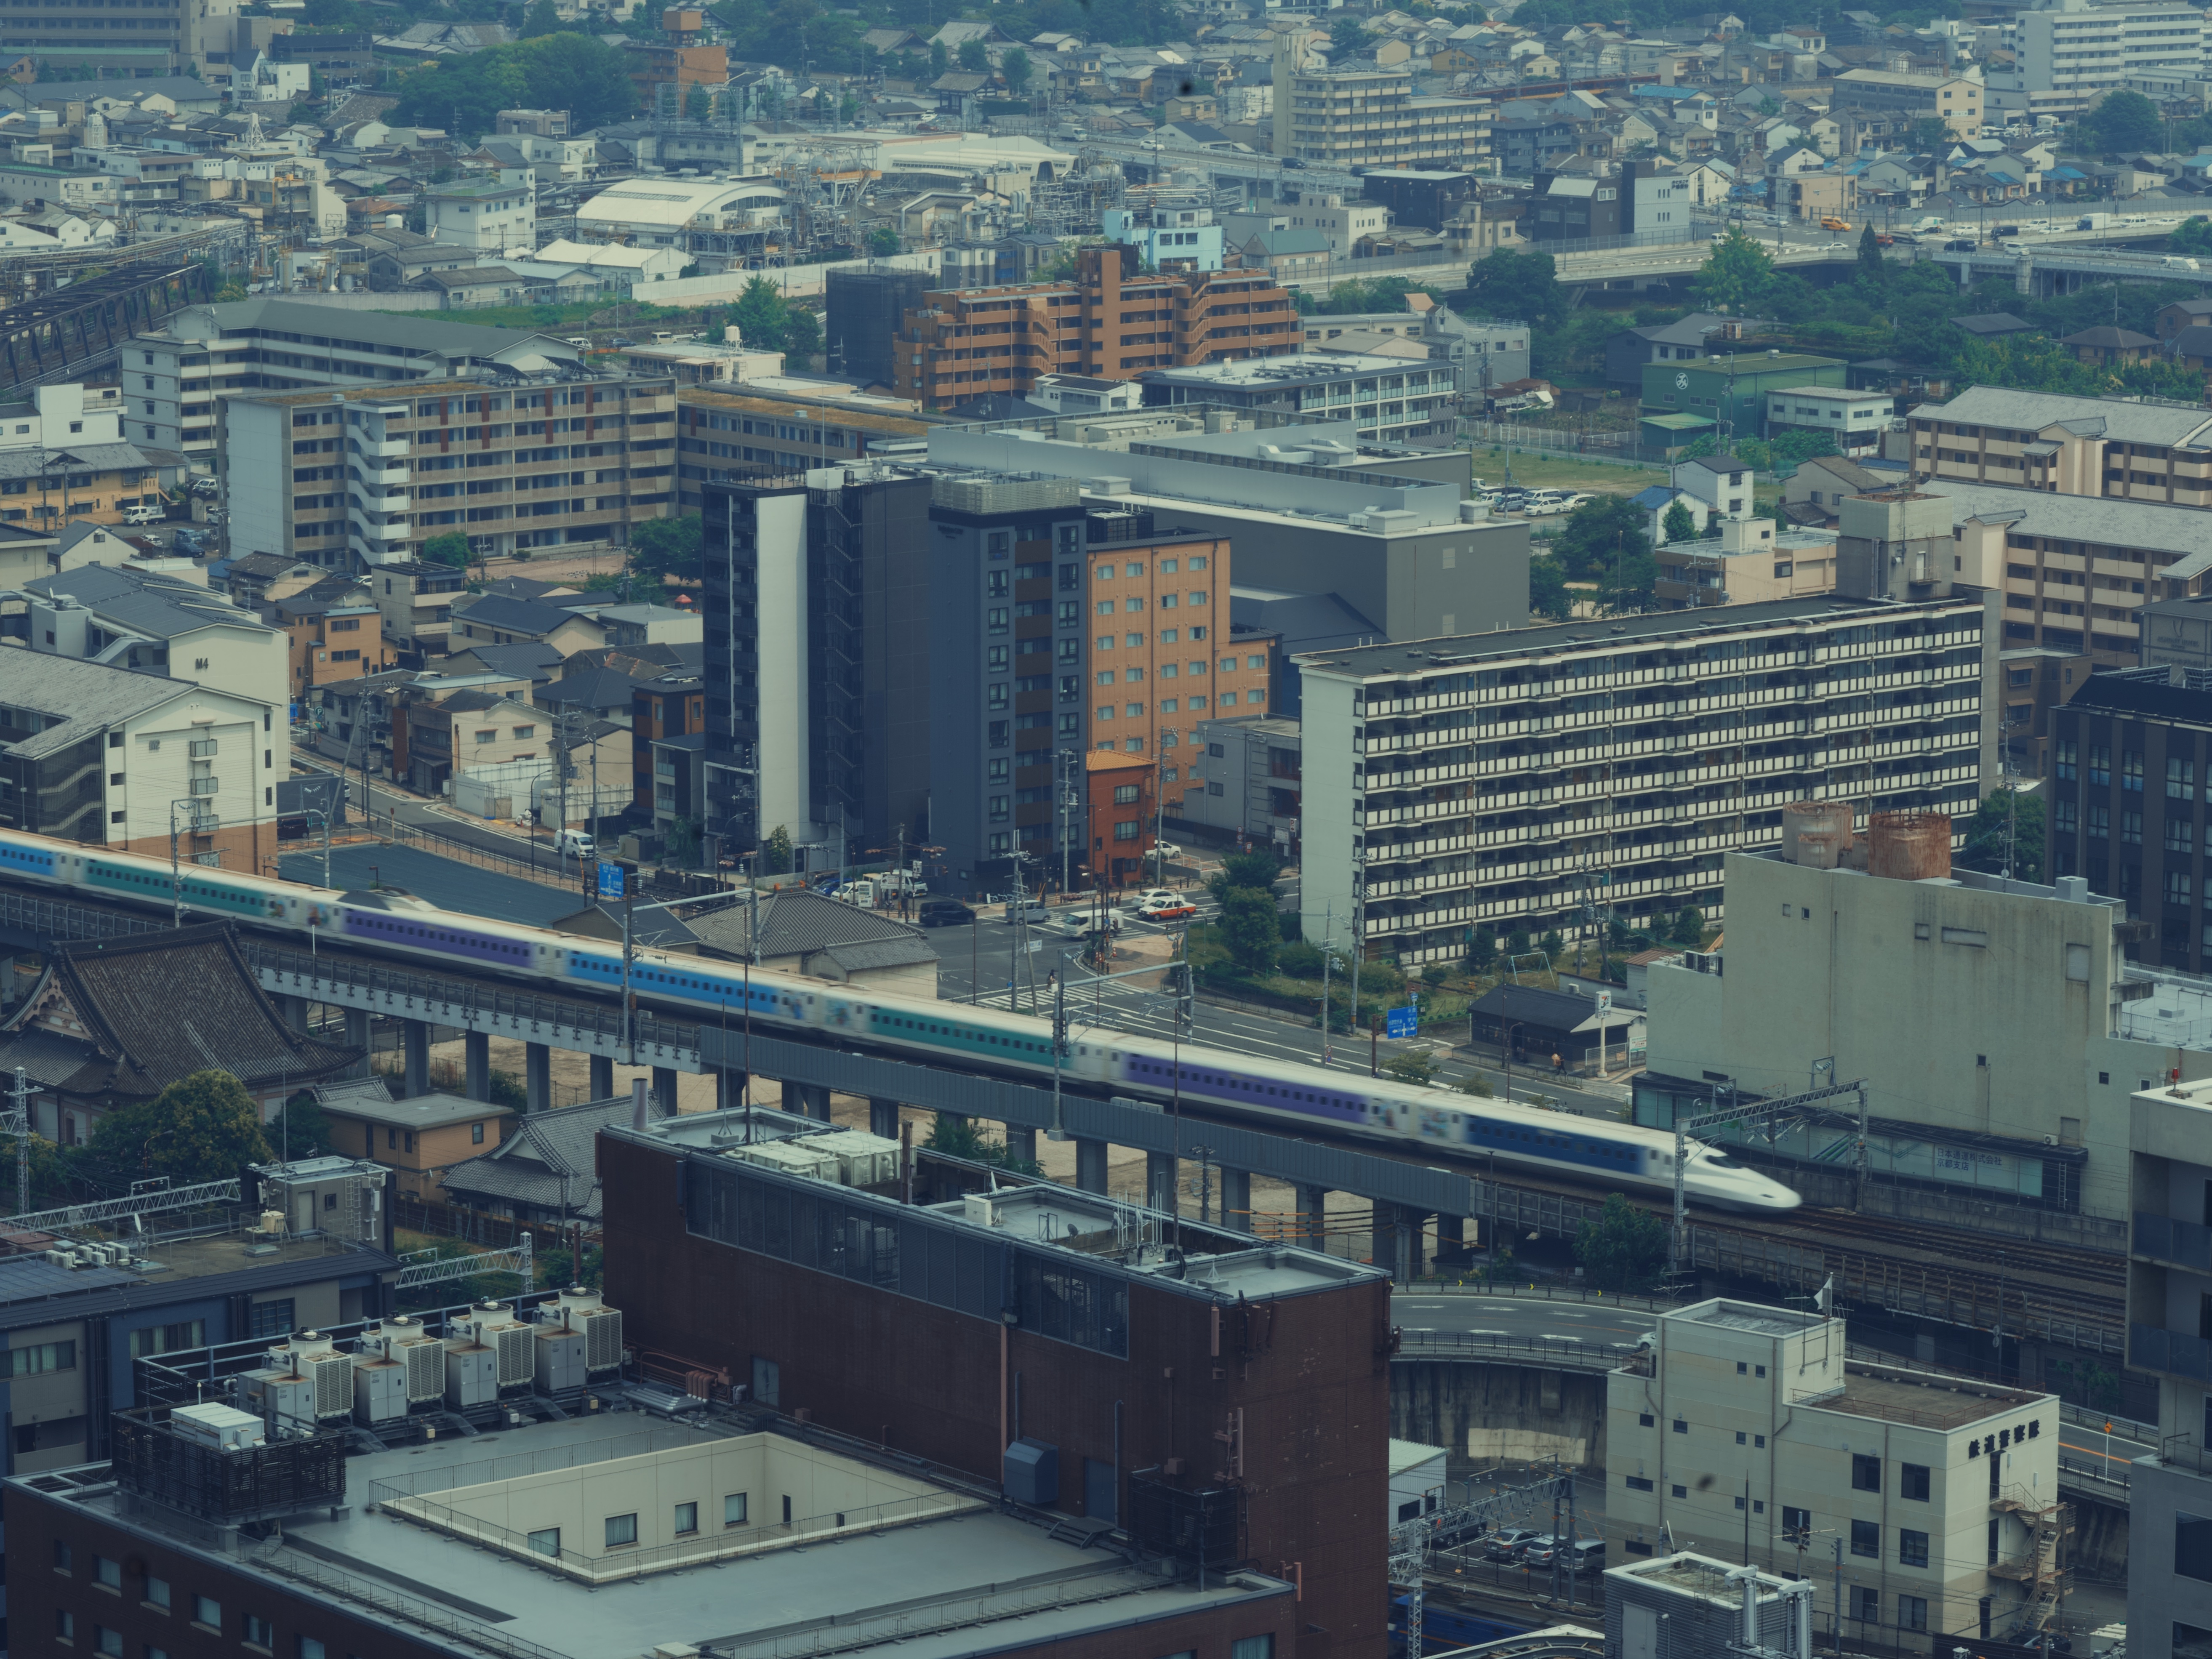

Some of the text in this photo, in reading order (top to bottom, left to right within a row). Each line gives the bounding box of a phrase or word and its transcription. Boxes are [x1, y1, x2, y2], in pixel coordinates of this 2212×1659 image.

[196, 658, 208, 669] M4
[1748, 1116, 1789, 1131] NIPON
[1937, 1148, 2002, 1166] 日本通運株式会社
[1937, 1158, 1969, 1171] 京都支店
[1969, 1419, 2040, 1459] 鉄道警察隊
